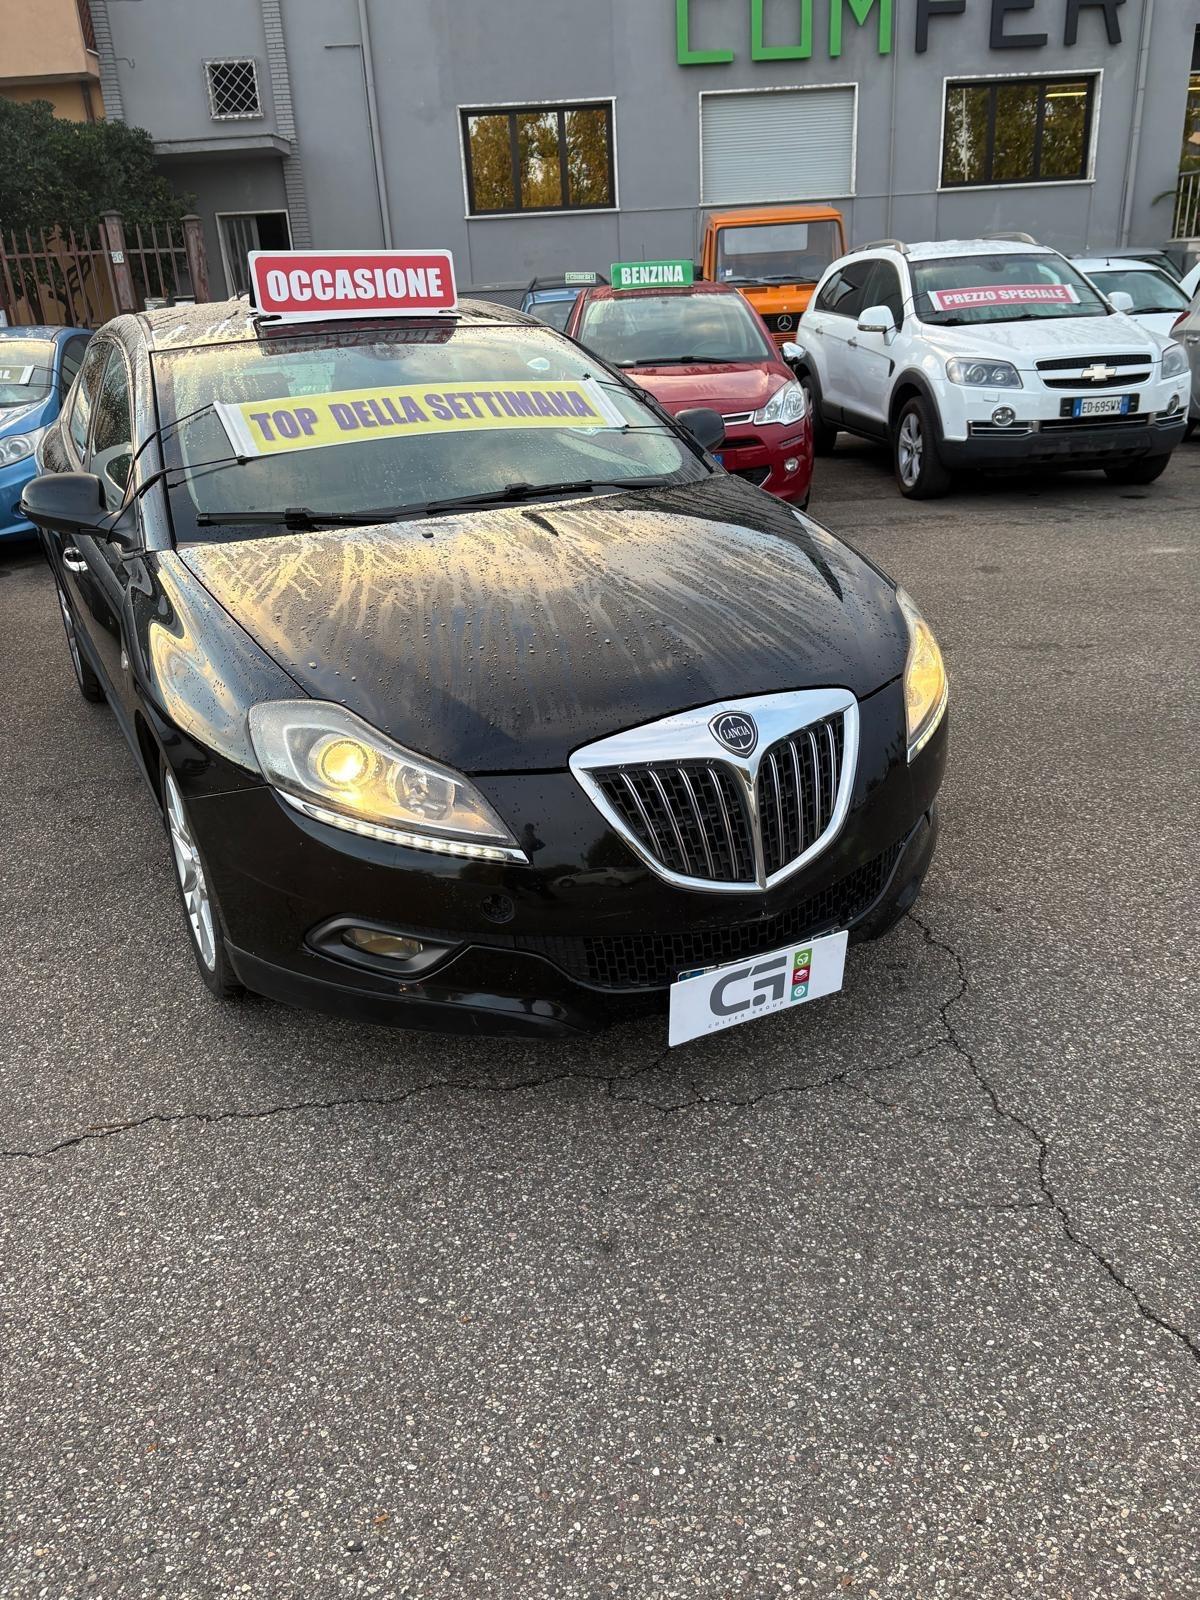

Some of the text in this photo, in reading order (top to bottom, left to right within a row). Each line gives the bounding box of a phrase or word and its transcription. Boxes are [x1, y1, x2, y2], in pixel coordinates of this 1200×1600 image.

[621, 265, 684, 285] BENZINA
[266, 268, 444, 302] OCCASIONE
[943, 289, 1066, 304] PREZZO SPECIALE
[250, 390, 598, 441] TOP DELLA SETTIMANA
[723, 726, 750, 740] LANCIA
[752, 1000, 785, 1015] GROUP
